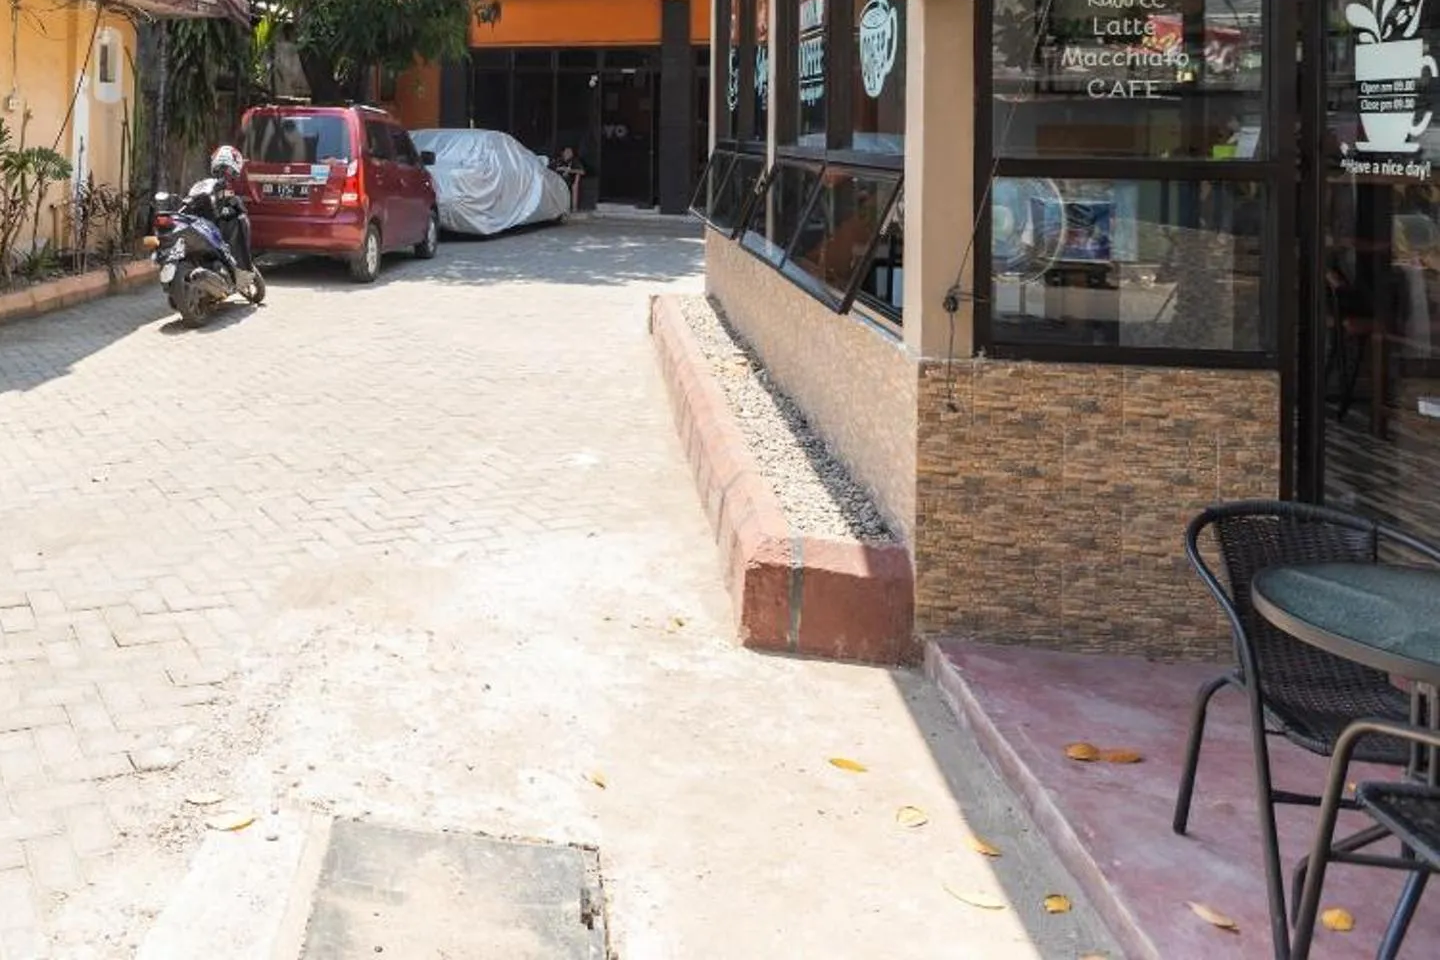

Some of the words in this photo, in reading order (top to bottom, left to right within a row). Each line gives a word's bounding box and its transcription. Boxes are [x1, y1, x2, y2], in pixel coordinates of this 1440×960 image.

[1093, 17, 1157, 36] Latte
[1061, 46, 1190, 69] Macchiato
[1087, 79, 1162, 99] CAFE
[1372, 161, 1380, 174] a
[1381, 158, 1404, 175] nice
[1405, 160, 1432, 181] day!
